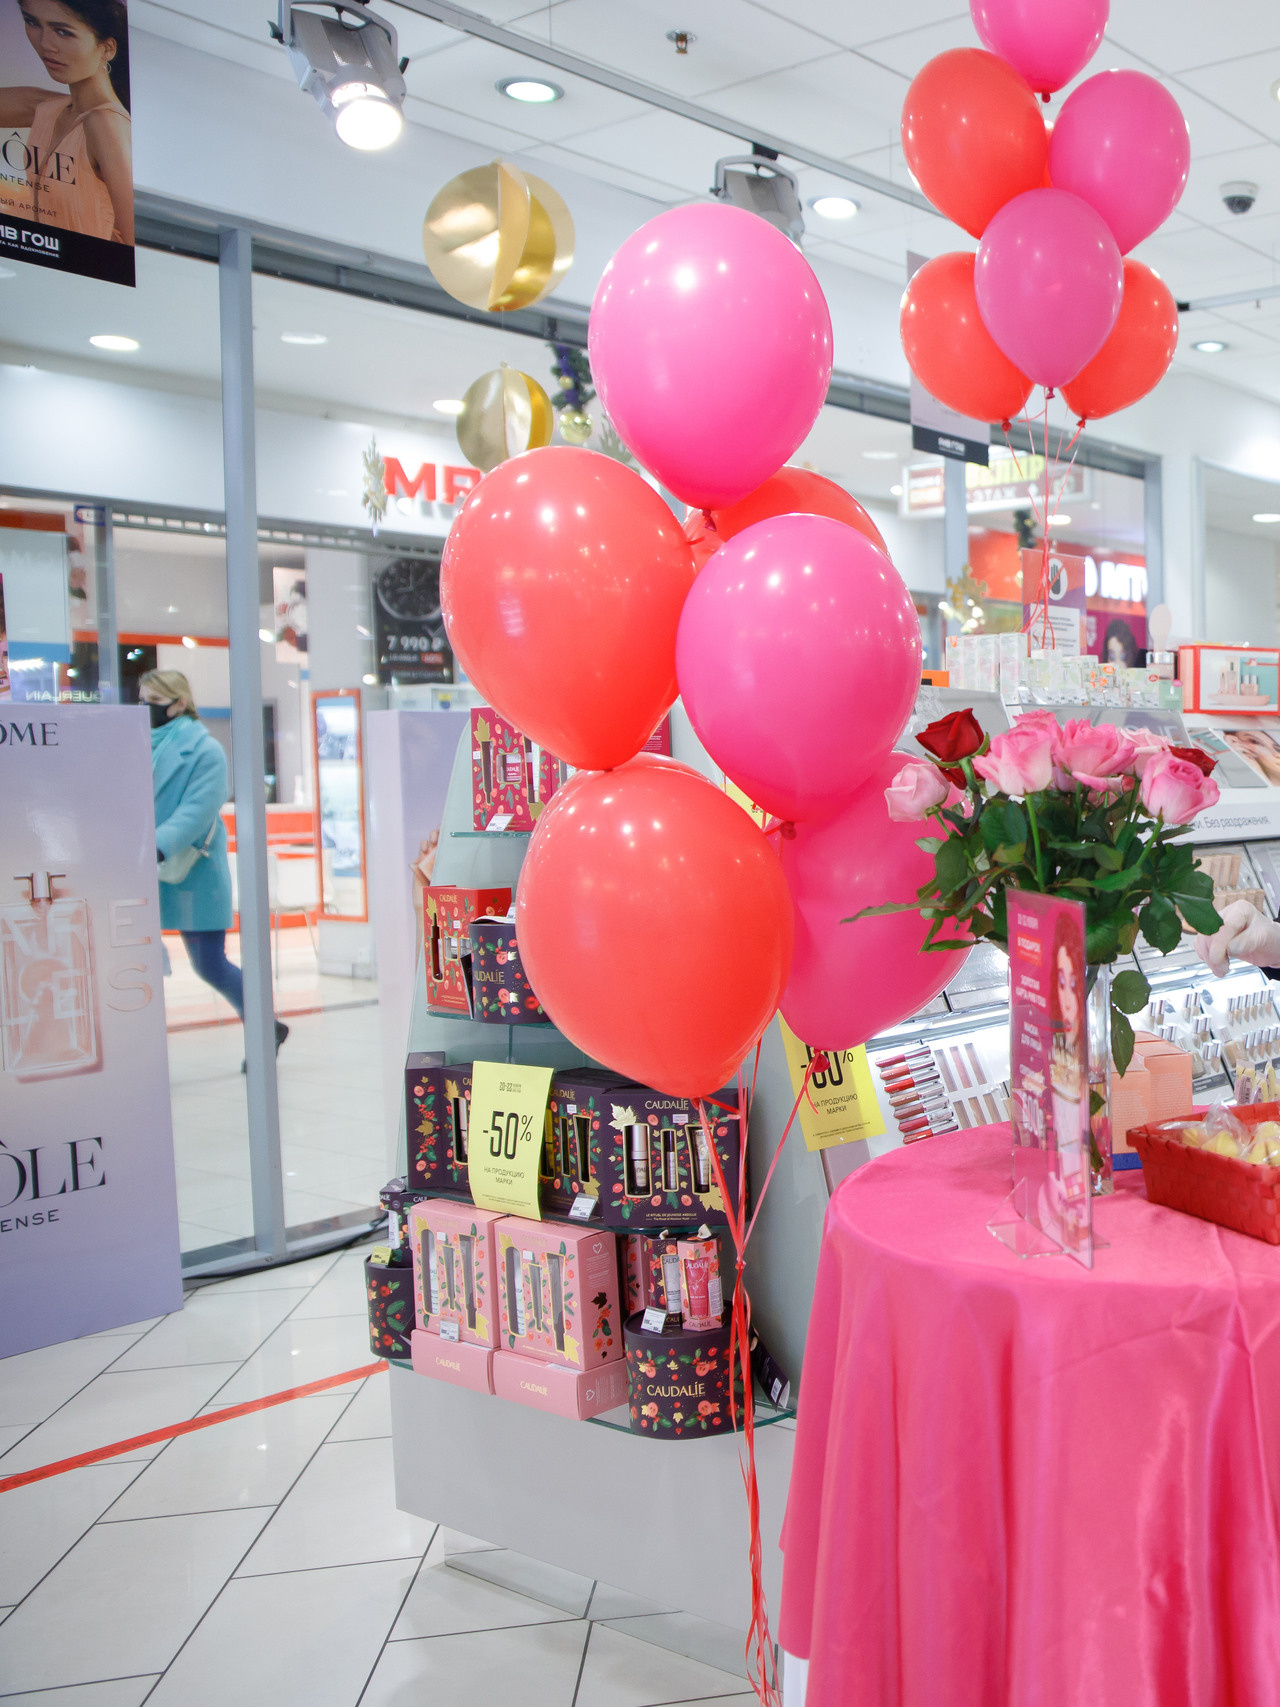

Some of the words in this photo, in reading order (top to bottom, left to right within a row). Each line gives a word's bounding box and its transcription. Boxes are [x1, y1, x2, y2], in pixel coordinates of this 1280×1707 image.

[19, 202, 58, 217] АРОМАТ
[21, 230, 60, 251] ГОШ
[821, 1093, 858, 1107] ПРОДУКЦИЮ
[826, 1105, 847, 1115] МАРКИ
[483, 1110, 534, 1160] -50%
[492, 1167, 525, 1179] ПРОДУКЦИЮ
[495, 1178, 513, 1186] МАРКИ
[1, 1209, 60, 1233] ENSE
